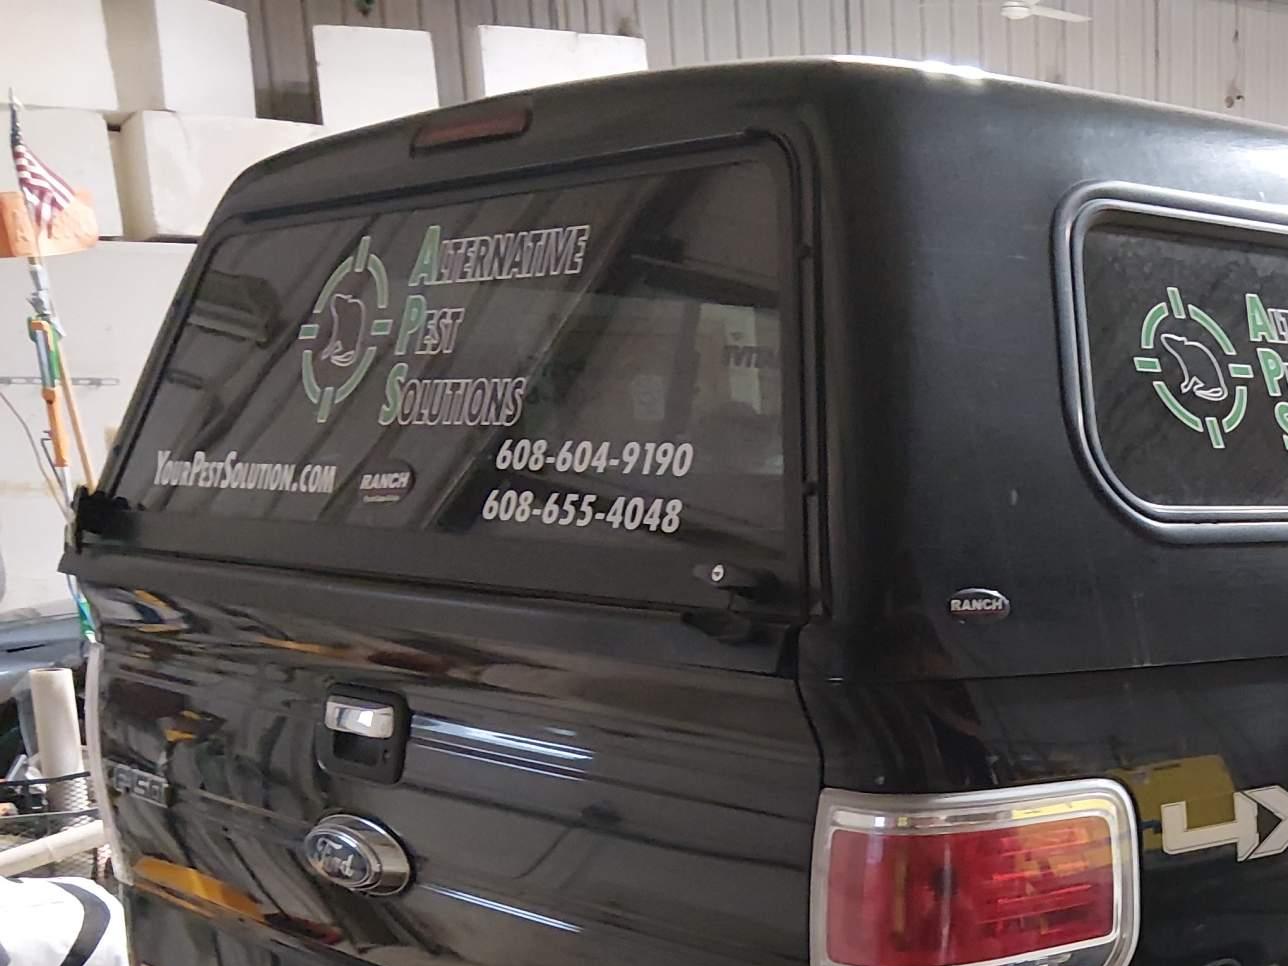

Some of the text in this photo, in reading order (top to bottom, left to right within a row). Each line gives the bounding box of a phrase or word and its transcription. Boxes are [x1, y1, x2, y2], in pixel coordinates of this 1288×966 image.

[495, 438, 694, 477] 608-604-9190
[360, 471, 412, 490] RANCH
[481, 489, 683, 534] 608-655-4048
[950, 598, 1003, 612] RANCH
